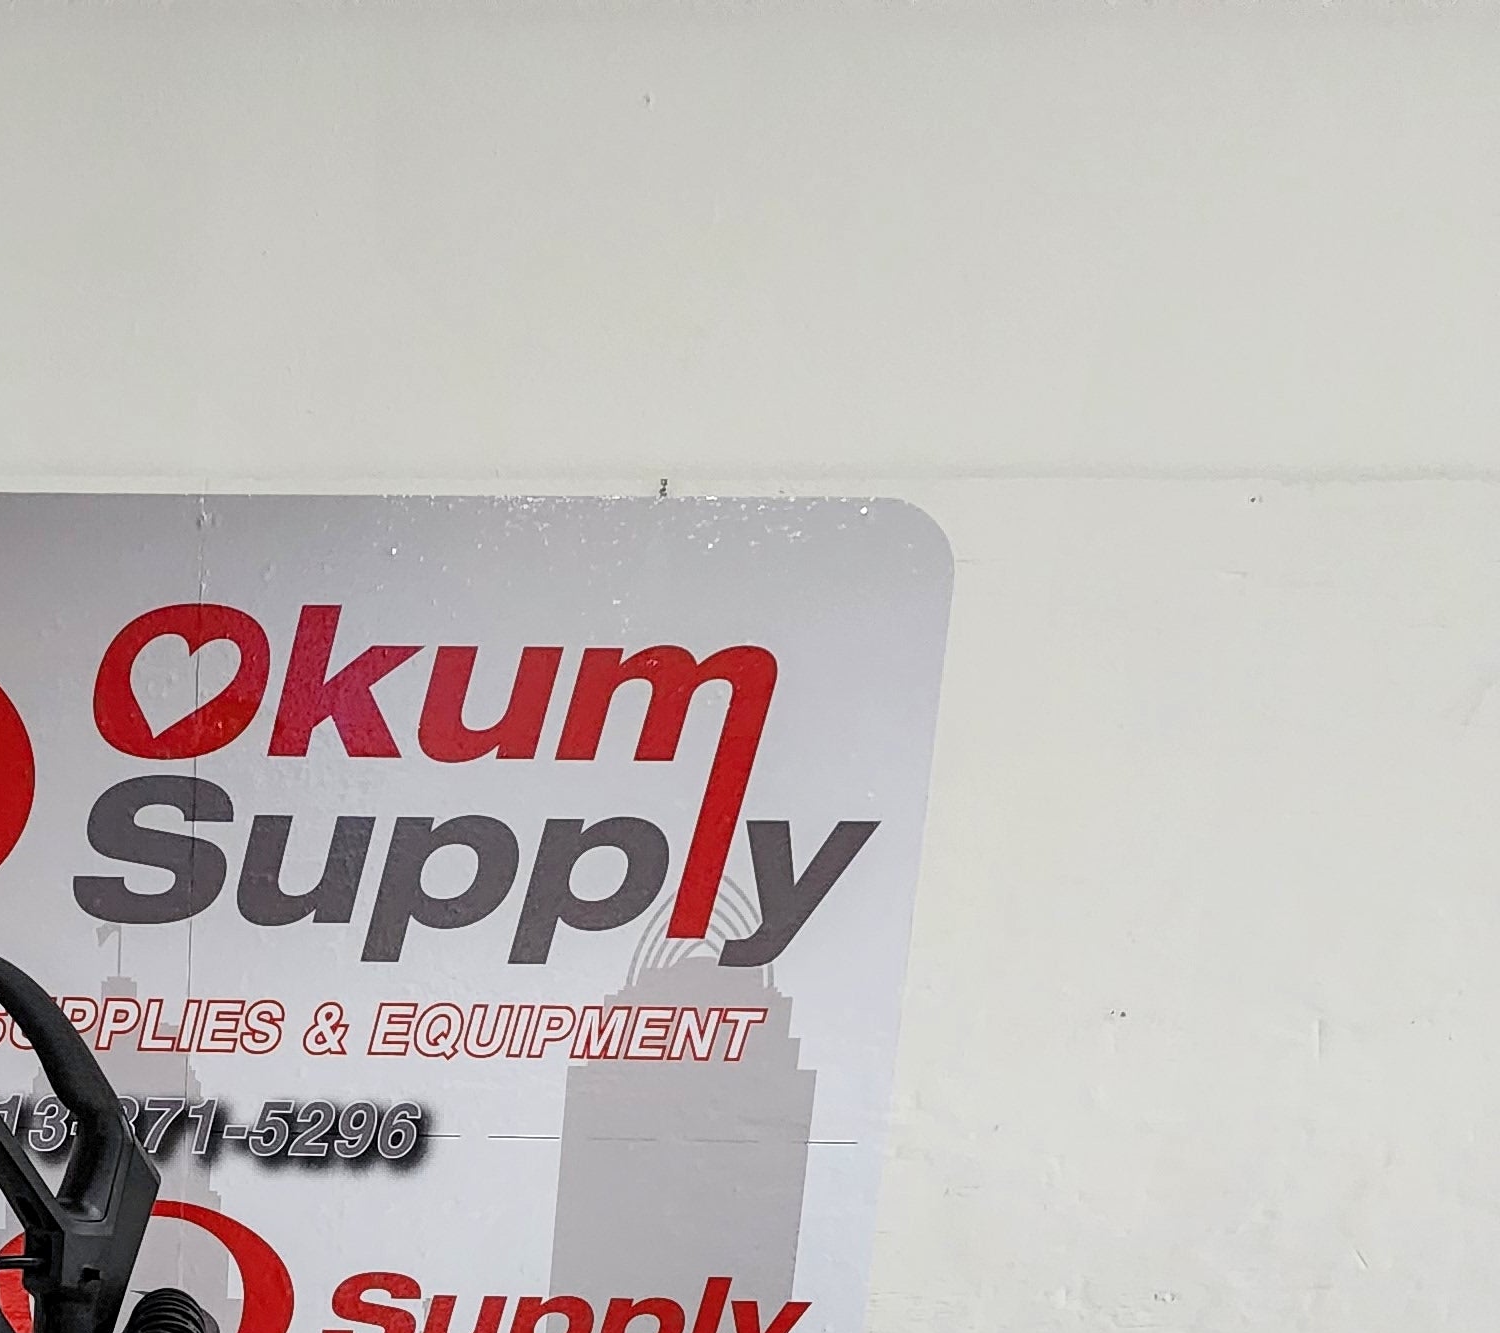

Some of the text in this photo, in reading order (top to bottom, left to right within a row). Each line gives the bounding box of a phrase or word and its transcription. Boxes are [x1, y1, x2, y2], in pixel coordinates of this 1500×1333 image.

[92, 603, 778, 785] Okum
[73, 775, 882, 967] Supply
[303, 1003, 347, 1054] &
[368, 1004, 768, 1060] EQUIPMENT
